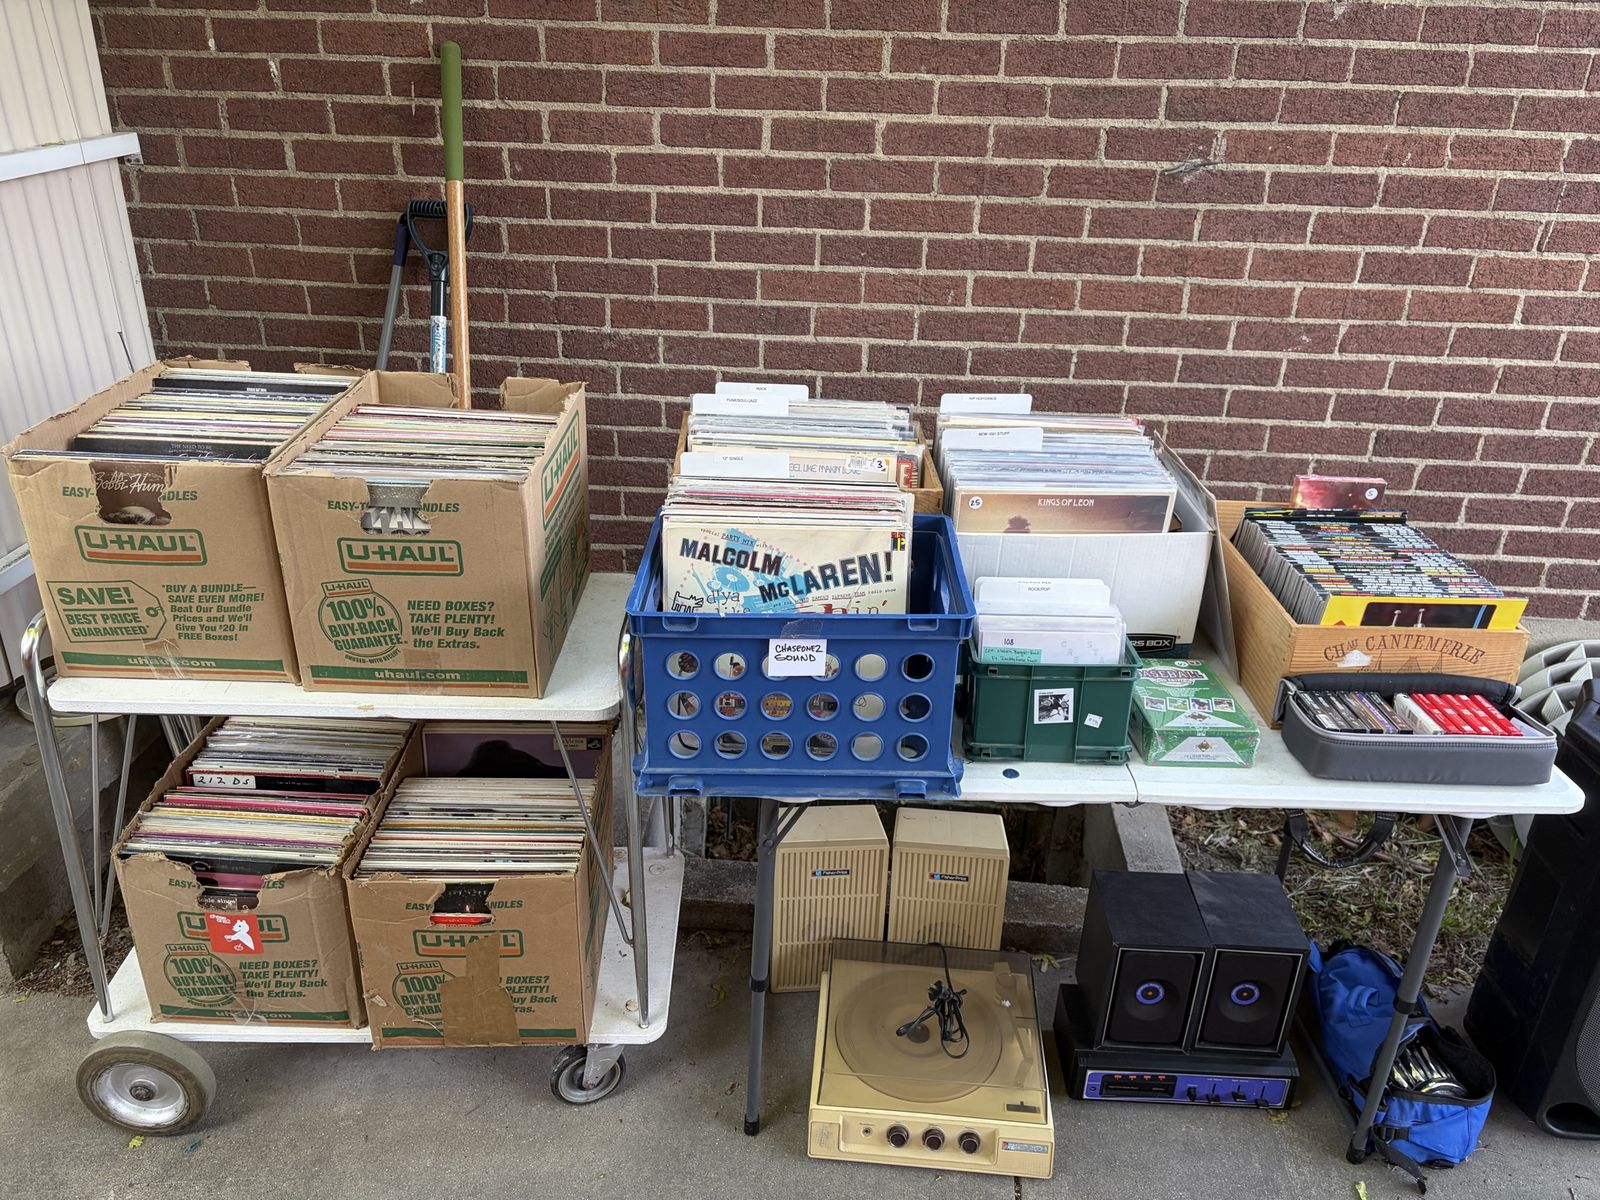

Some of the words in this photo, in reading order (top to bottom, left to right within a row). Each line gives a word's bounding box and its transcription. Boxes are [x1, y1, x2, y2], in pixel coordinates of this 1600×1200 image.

[803, 465, 817, 473] LIKE
[877, 460, 883, 469] 3
[62, 486, 95, 498] EASY-
[327, 499, 369, 511] EASY-T
[422, 503, 460, 512] NDLES
[1037, 498, 1060, 506] KINGS
[1061, 498, 1072, 506] OF
[1073, 499, 1095, 507] LEON
[82, 531, 197, 552] U-HAUL
[345, 543, 455, 562] U-HAUL
[680, 537, 783, 576] MALCOLM
[324, 581, 370, 592] U-HAUL
[58, 586, 136, 606] SAVE!
[168, 595, 194, 604] SAVE
[198, 594, 225, 603] EVEN
[229, 593, 264, 603] MORE!
[170, 605, 194, 613] Beat
[196, 605, 213, 613] Our
[216, 604, 252, 613] Bundle
[326, 597, 386, 622] 100%
[407, 600, 441, 611] NEED
[445, 601, 496, 612] BOXES?
[68, 614, 98, 625] BEST
[103, 612, 142, 625] PRICE
[173, 614, 202, 623] Prices
[206, 614, 223, 622] and
[227, 613, 253, 622] We'll
[409, 613, 441, 623] TAKE
[445, 614, 496, 624] PLENTY!
[175, 623, 194, 632] Give
[198, 623, 217, 632] You
[219, 624, 235, 632] $20
[239, 623, 248, 632] in
[328, 618, 398, 638] BUY-BACK
[411, 625, 441, 636] We'll
[446, 626, 470, 638] Buy
[474, 627, 505, 637] Back
[178, 633, 202, 641] FREE
[205, 633, 238, 642] Boxes!
[413, 639, 434, 649] the
[437, 639, 480, 649] Extras.
[1365, 633, 1486, 665] CANTEMERLE
[774, 654, 816, 662] SOUND
[375, 669, 461, 681] uhaul.com
[405, 902, 432, 911] EASY-
[168, 944, 206, 952] U-HAUL
[169, 957, 222, 975] 100%
[239, 961, 269, 970] NEED
[273, 960, 318, 969] BOXES?
[400, 962, 440, 970] U-HAUL
[241, 971, 269, 979] TAKE
[273, 969, 319, 979] PLENTY!
[506, 975, 550, 984] BOXES?
[172, 974, 233, 986] BUY-BACK
[244, 980, 271, 989] We'll
[275, 979, 297, 990] Buy
[299, 978, 327, 988] Back
[268, 989, 306, 998] Extras.
[511, 995, 527, 1005] uy
[530, 995, 558, 1003] Back
[513, 1005, 536, 1013] ras.
